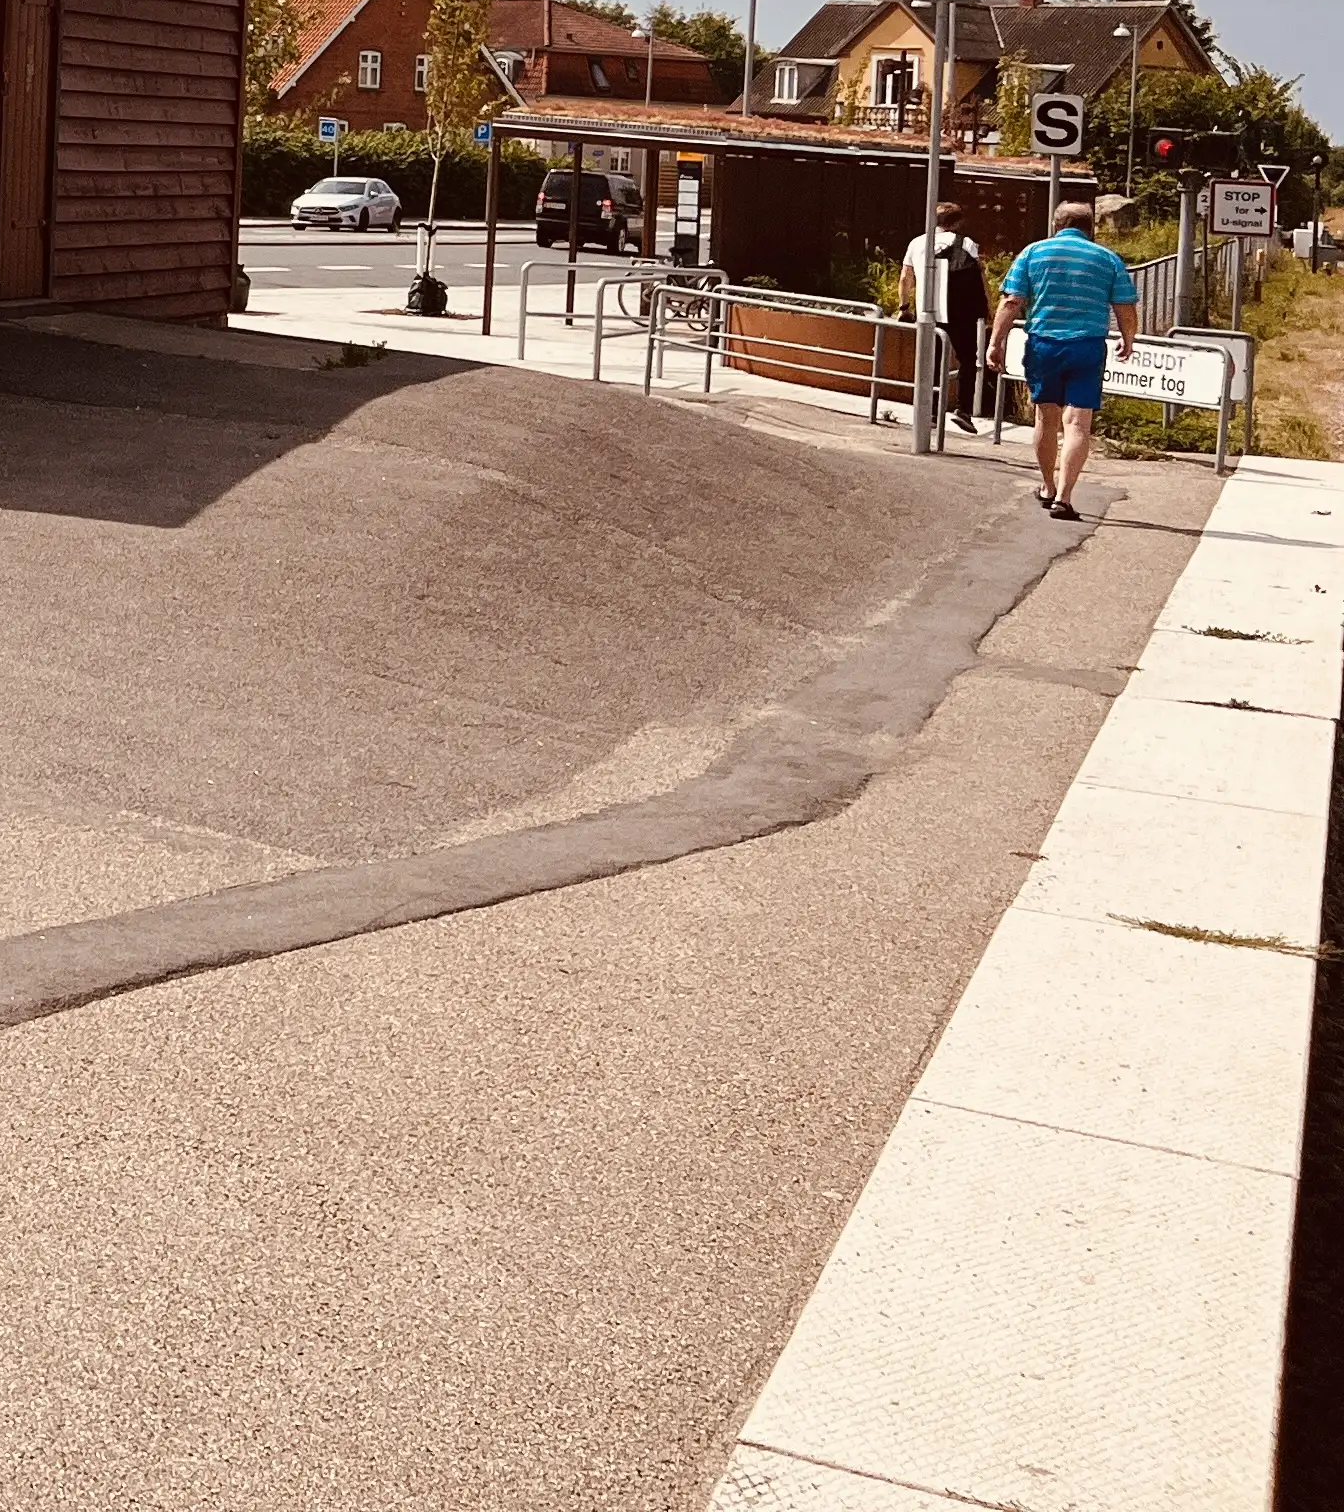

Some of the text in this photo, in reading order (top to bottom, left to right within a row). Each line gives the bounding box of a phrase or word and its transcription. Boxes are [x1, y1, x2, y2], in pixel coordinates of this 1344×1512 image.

[322, 125, 334, 134] 40
[1034, 100, 1079, 148] S
[478, 126, 487, 137] P
[1224, 190, 1261, 203] STOP
[1235, 206, 1249, 214] for
[1221, 218, 1263, 228] U-signal
[1103, 368, 1185, 397] ommer tog
